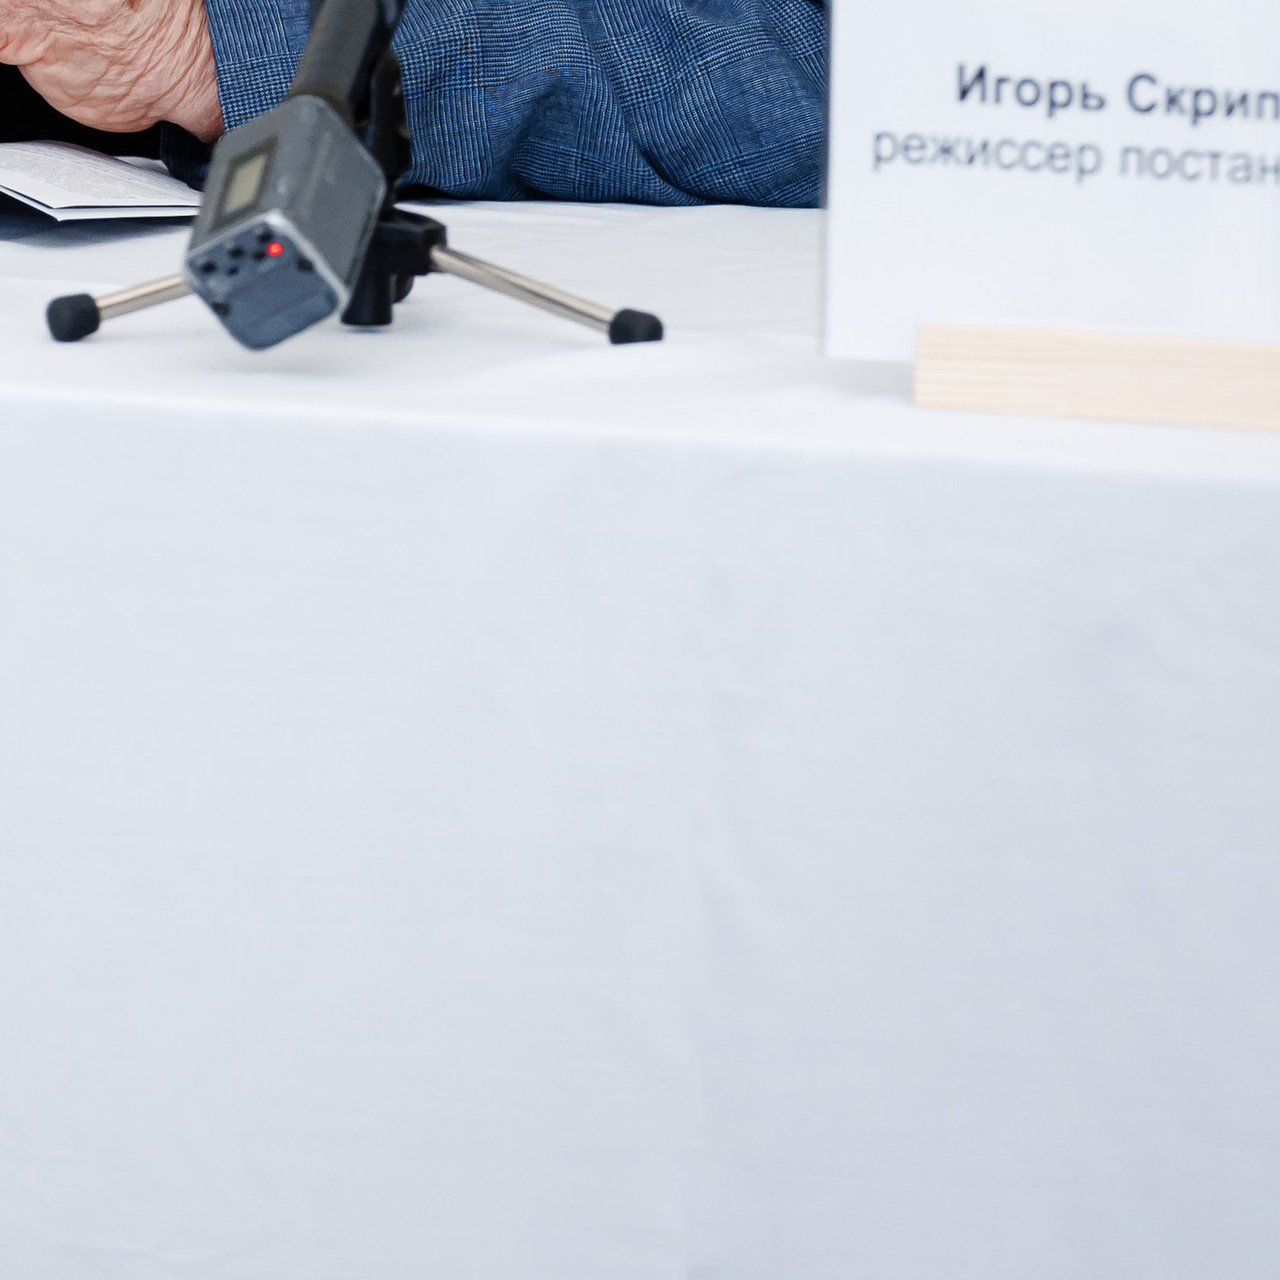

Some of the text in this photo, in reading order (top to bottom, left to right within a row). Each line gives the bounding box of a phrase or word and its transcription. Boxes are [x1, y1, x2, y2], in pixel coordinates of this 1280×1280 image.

[957, 63, 1280, 125] Игорь Скрип
[872, 132, 1104, 185] режиссер
